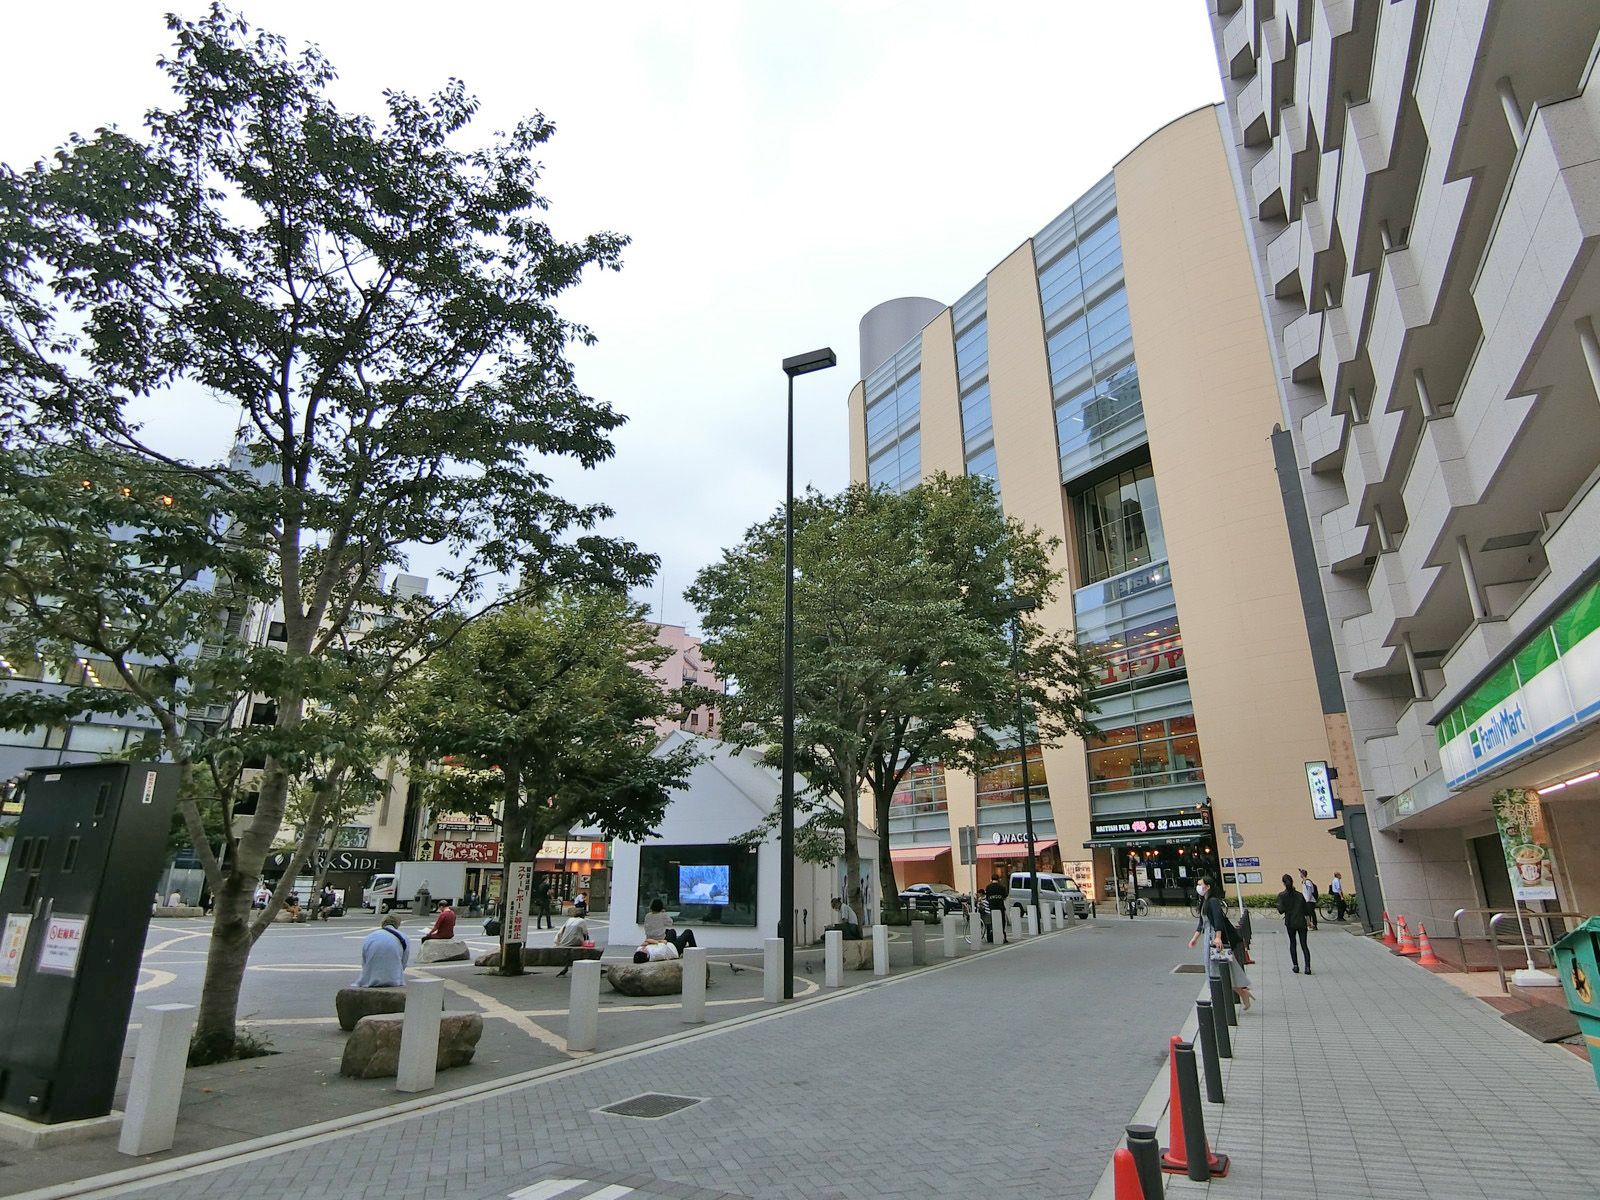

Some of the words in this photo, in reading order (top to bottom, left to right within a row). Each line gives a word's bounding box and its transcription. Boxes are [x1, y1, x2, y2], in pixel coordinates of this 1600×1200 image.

[1478, 702, 1526, 753] FamilyMart
[1118, 823, 1131, 832] PUB
[1157, 820, 1168, 831] 82
[1169, 819, 1182, 828] ALE
[512, 866, 526, 939] スケートボード等禁止
